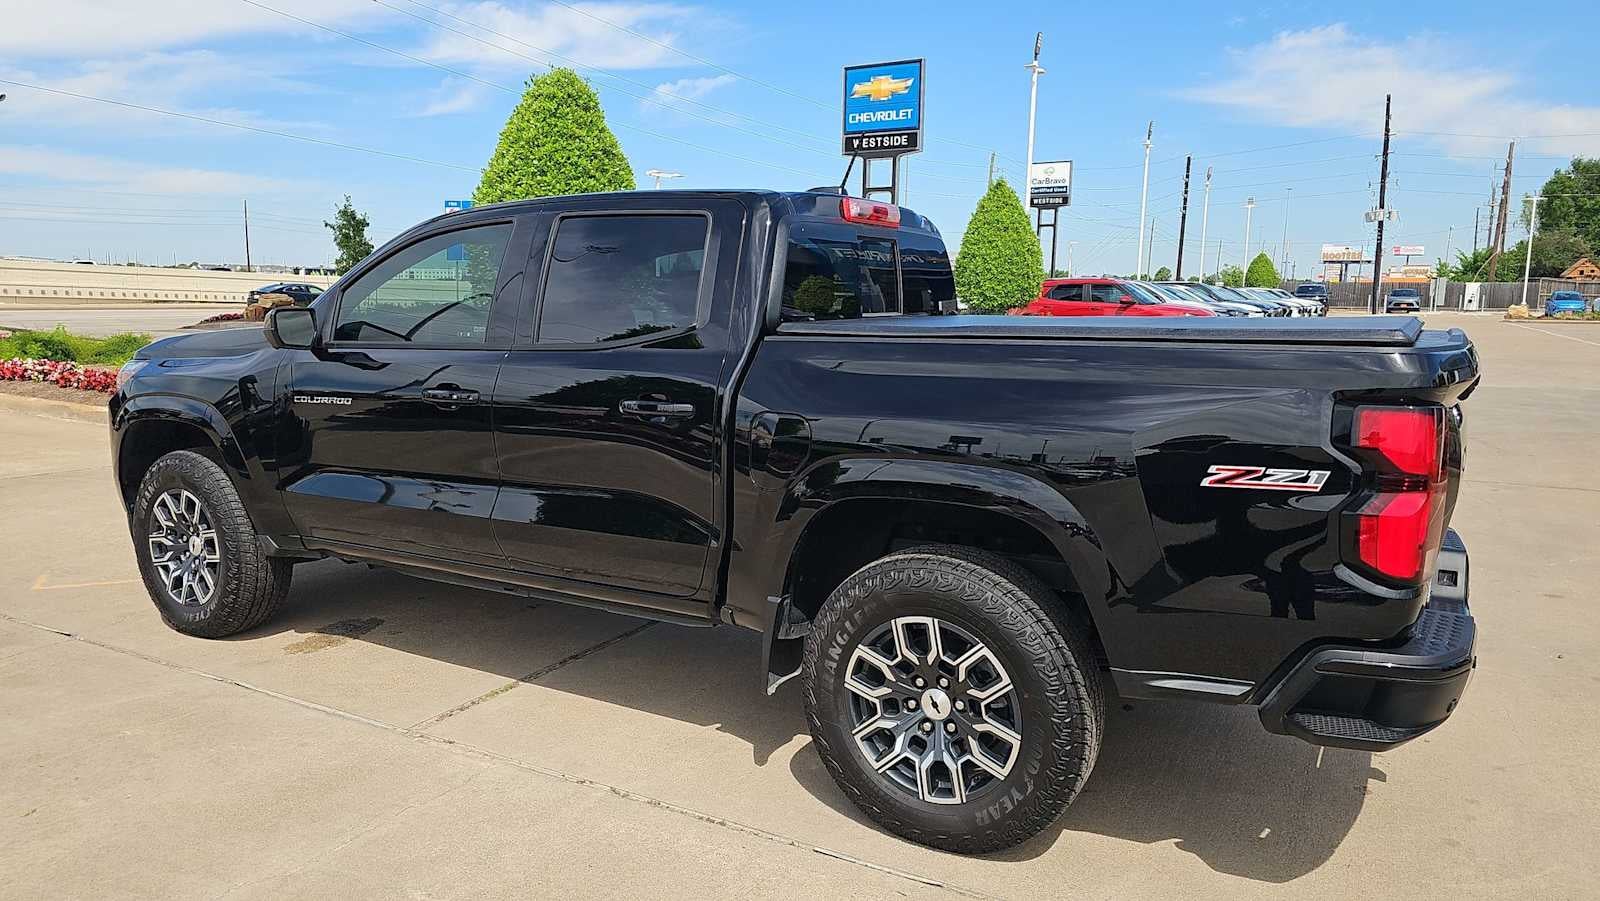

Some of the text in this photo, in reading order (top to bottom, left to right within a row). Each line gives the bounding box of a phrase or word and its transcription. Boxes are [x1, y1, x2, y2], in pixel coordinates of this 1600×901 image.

[848, 108, 913, 124] CHEVROLET
[1032, 177, 1067, 185] CarBravo
[1033, 197, 1063, 205] WESTSIDE
[294, 395, 353, 405] COLORADO
[1200, 465, 1332, 493] Z71
